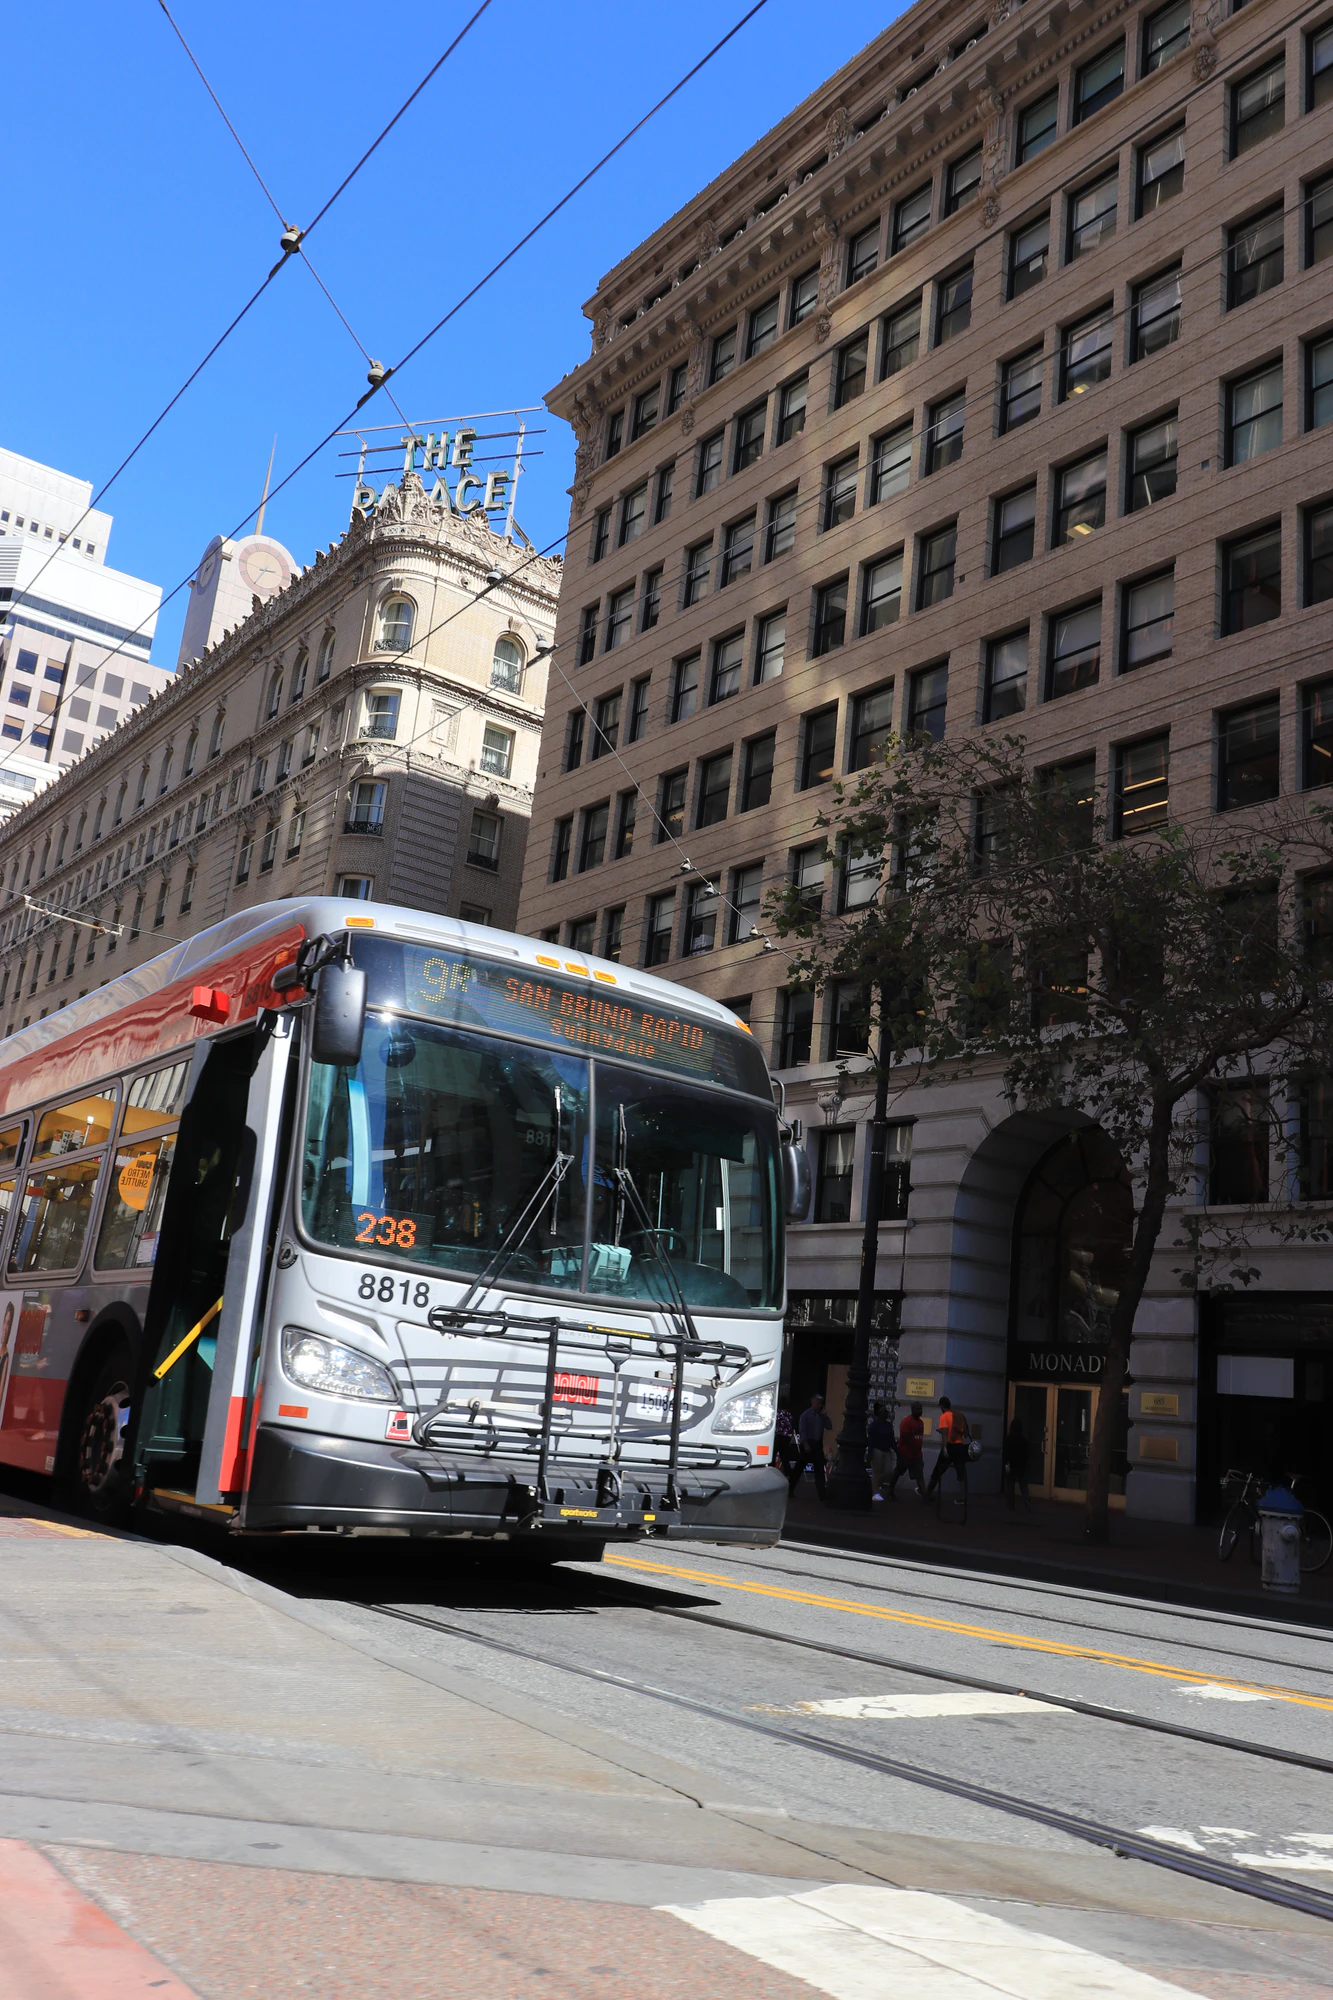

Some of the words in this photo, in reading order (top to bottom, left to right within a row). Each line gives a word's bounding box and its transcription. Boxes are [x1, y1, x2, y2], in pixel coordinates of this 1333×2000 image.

[401, 428, 477, 472] THE
[353, 470, 509, 514] PAACE
[421, 957, 471, 1002] 9R
[504, 978, 551, 1010] SAN
[560, 992, 633, 1031] BRUNO
[641, 1013, 704, 1049] RAPID
[550, 1018, 656, 1059] Sunnydale
[355, 1212, 417, 1249] 238
[358, 1273, 430, 1309] 8818
[1029, 1352, 1130, 1374] MONAD
